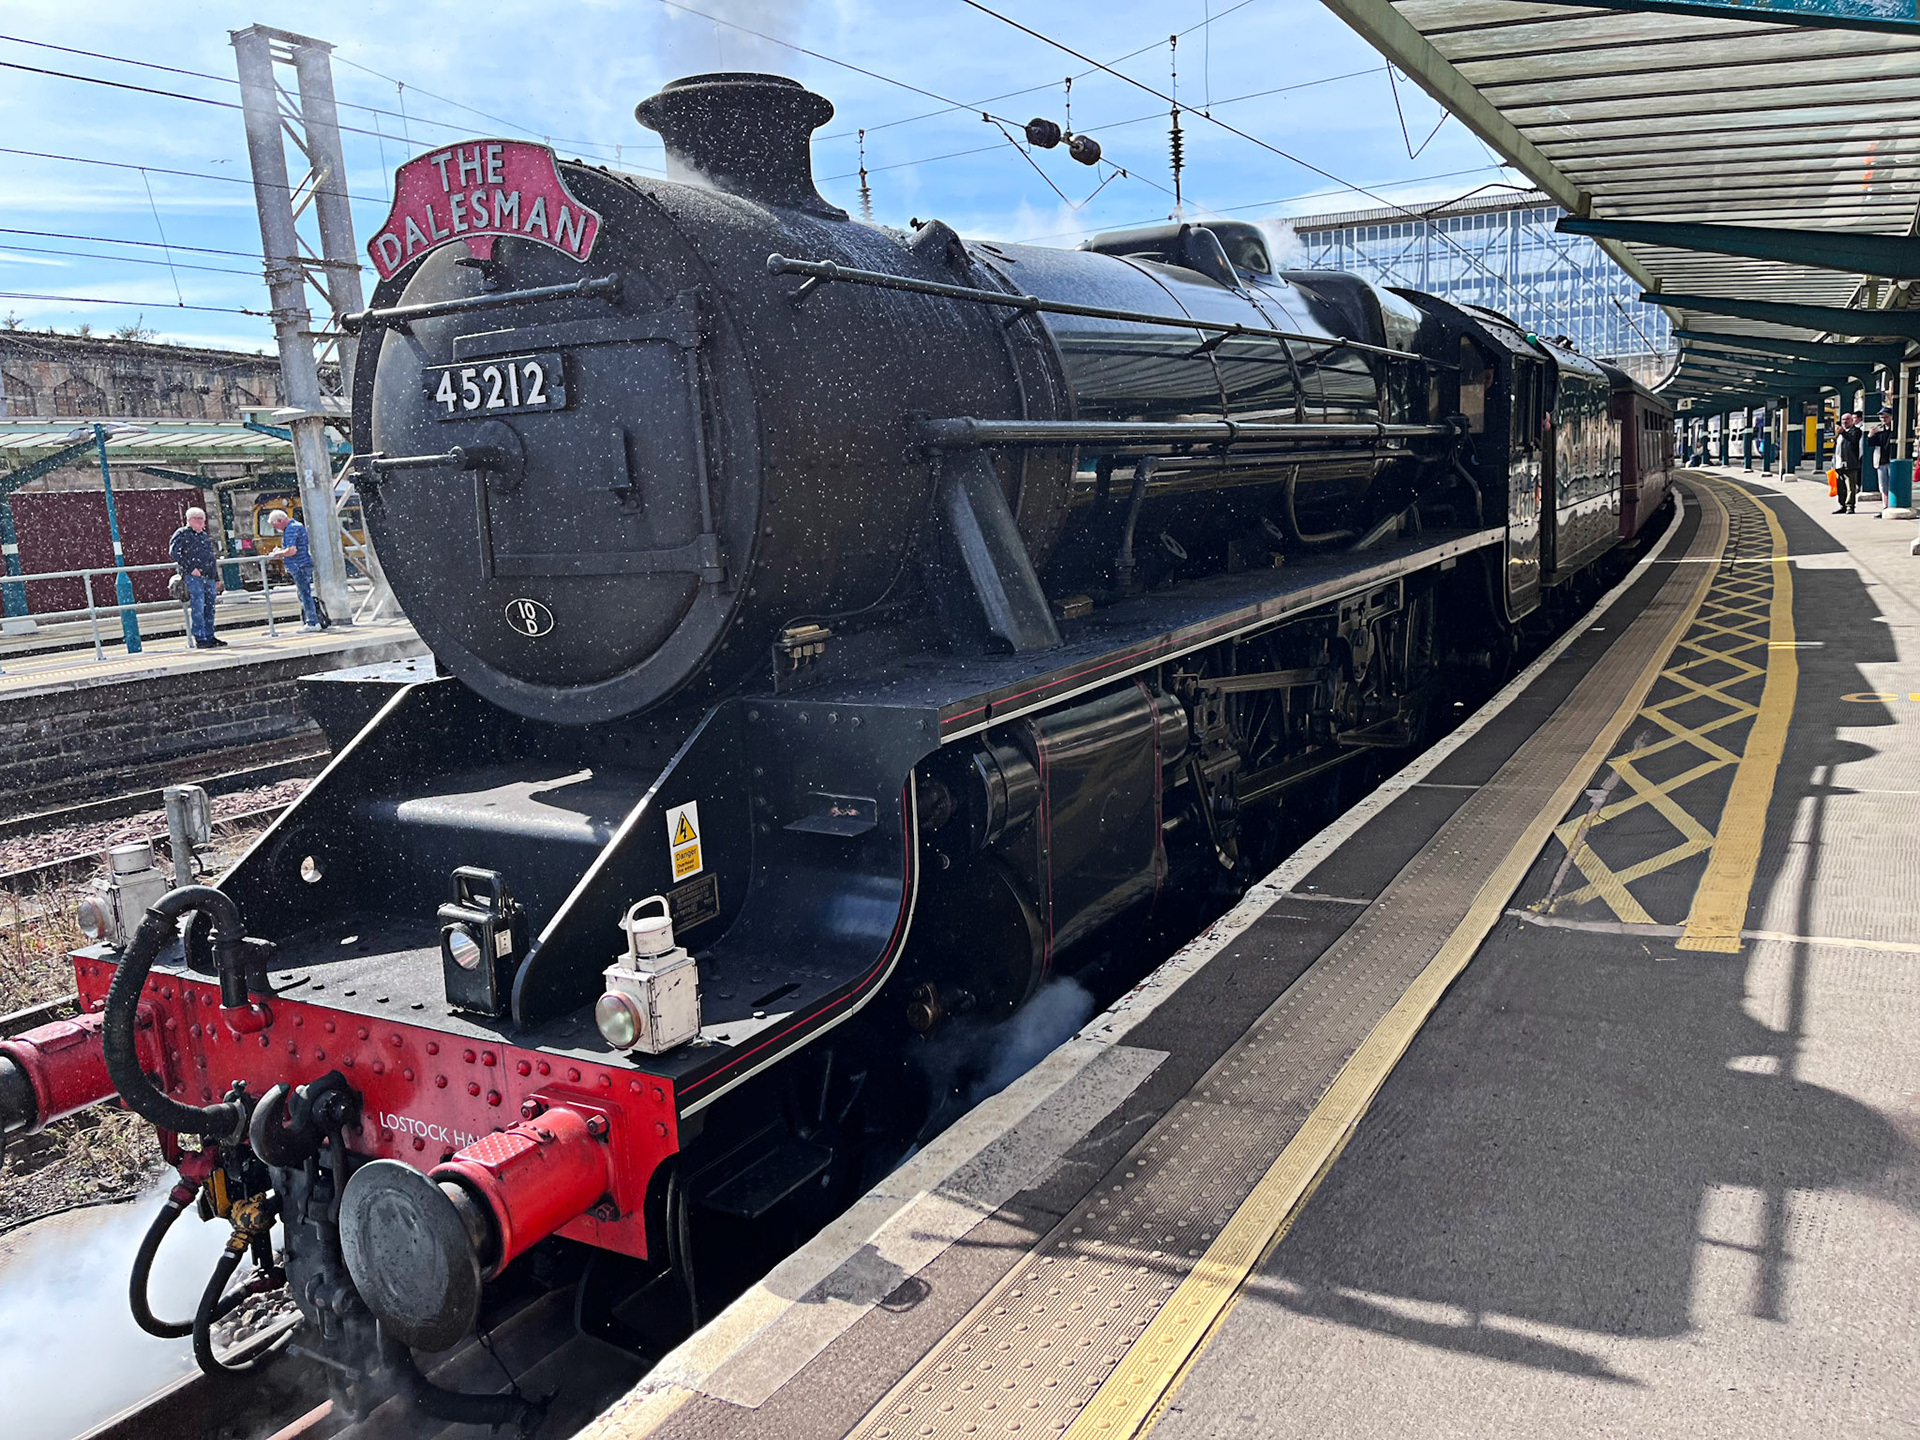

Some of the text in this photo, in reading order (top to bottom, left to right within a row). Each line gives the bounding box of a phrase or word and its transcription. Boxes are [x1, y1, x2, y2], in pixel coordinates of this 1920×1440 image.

[431, 144, 504, 192] THE
[376, 188, 587, 272] DALESMAN
[436, 361, 547, 412] 45212
[1681, 400, 1689, 408] 4
[517, 601, 536, 620] 10
[526, 619, 538, 634] D
[676, 848, 697, 861] Danger
[380, 1111, 450, 1144] LOSTOCK
